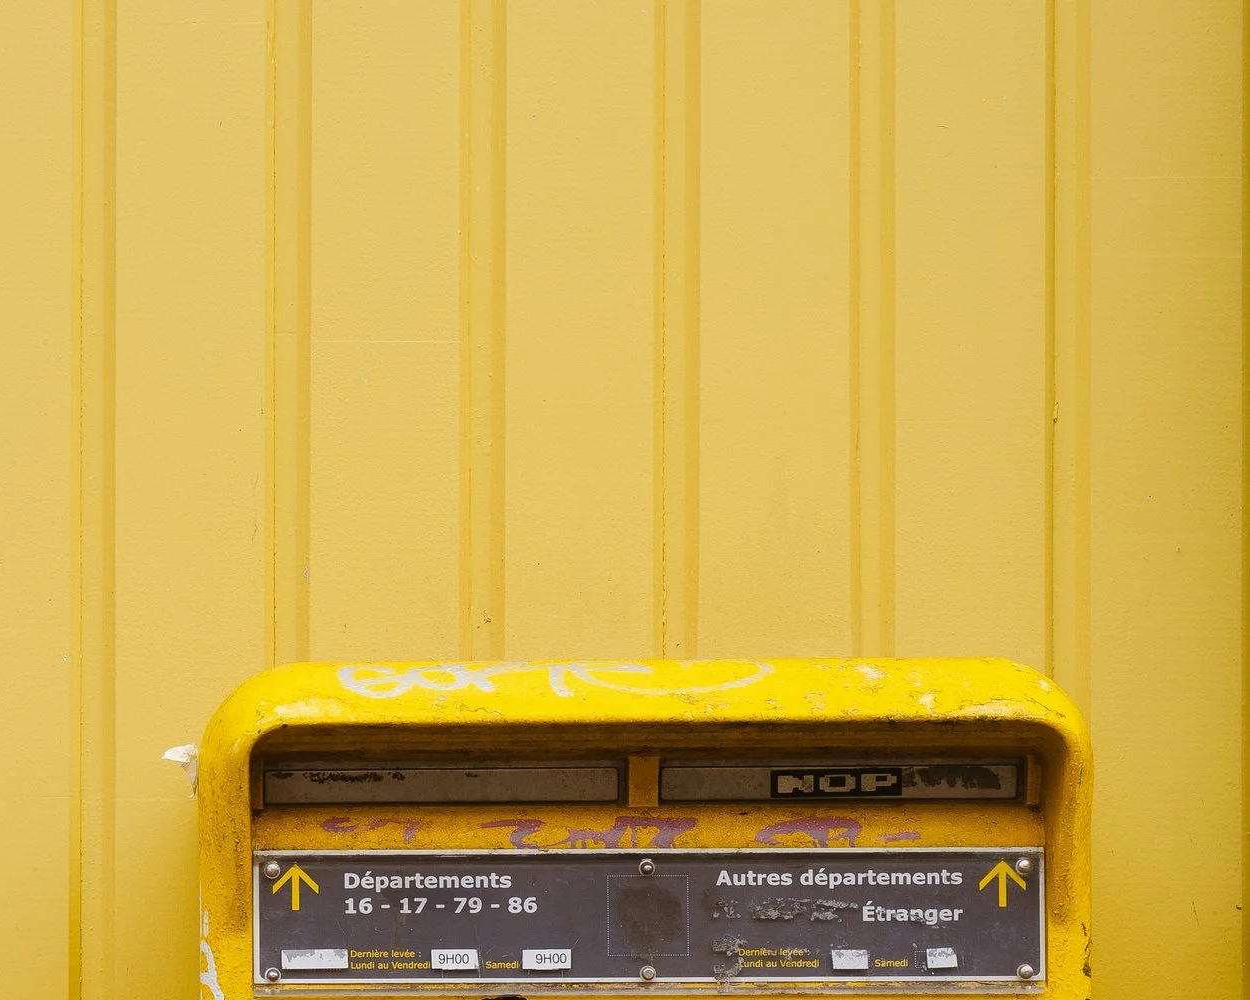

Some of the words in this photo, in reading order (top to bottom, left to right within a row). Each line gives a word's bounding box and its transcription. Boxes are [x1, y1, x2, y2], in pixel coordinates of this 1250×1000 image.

[777, 774, 898, 794] NOP
[344, 871, 512, 893] Départements
[716, 870, 793, 886] Autres
[799, 868, 964, 889] départements
[344, 897, 374, 915] 16
[399, 897, 428, 914] 17
[453, 897, 483, 914] 79
[507, 896, 538, 914] 86
[862, 901, 964, 925] Étranger
[350, 949, 389, 958] Dernière
[391, 949, 416, 958] levée
[779, 947, 804, 957] levée
[438, 953, 470, 965] 9H00
[535, 953, 567, 965] 9H00
[780, 959, 820, 969] Vendredi
[874, 959, 909, 968] Samedi
[350, 961, 375, 970] Lundi
[391, 961, 431, 970] Vendredi
[485, 961, 519, 970] Samedi
